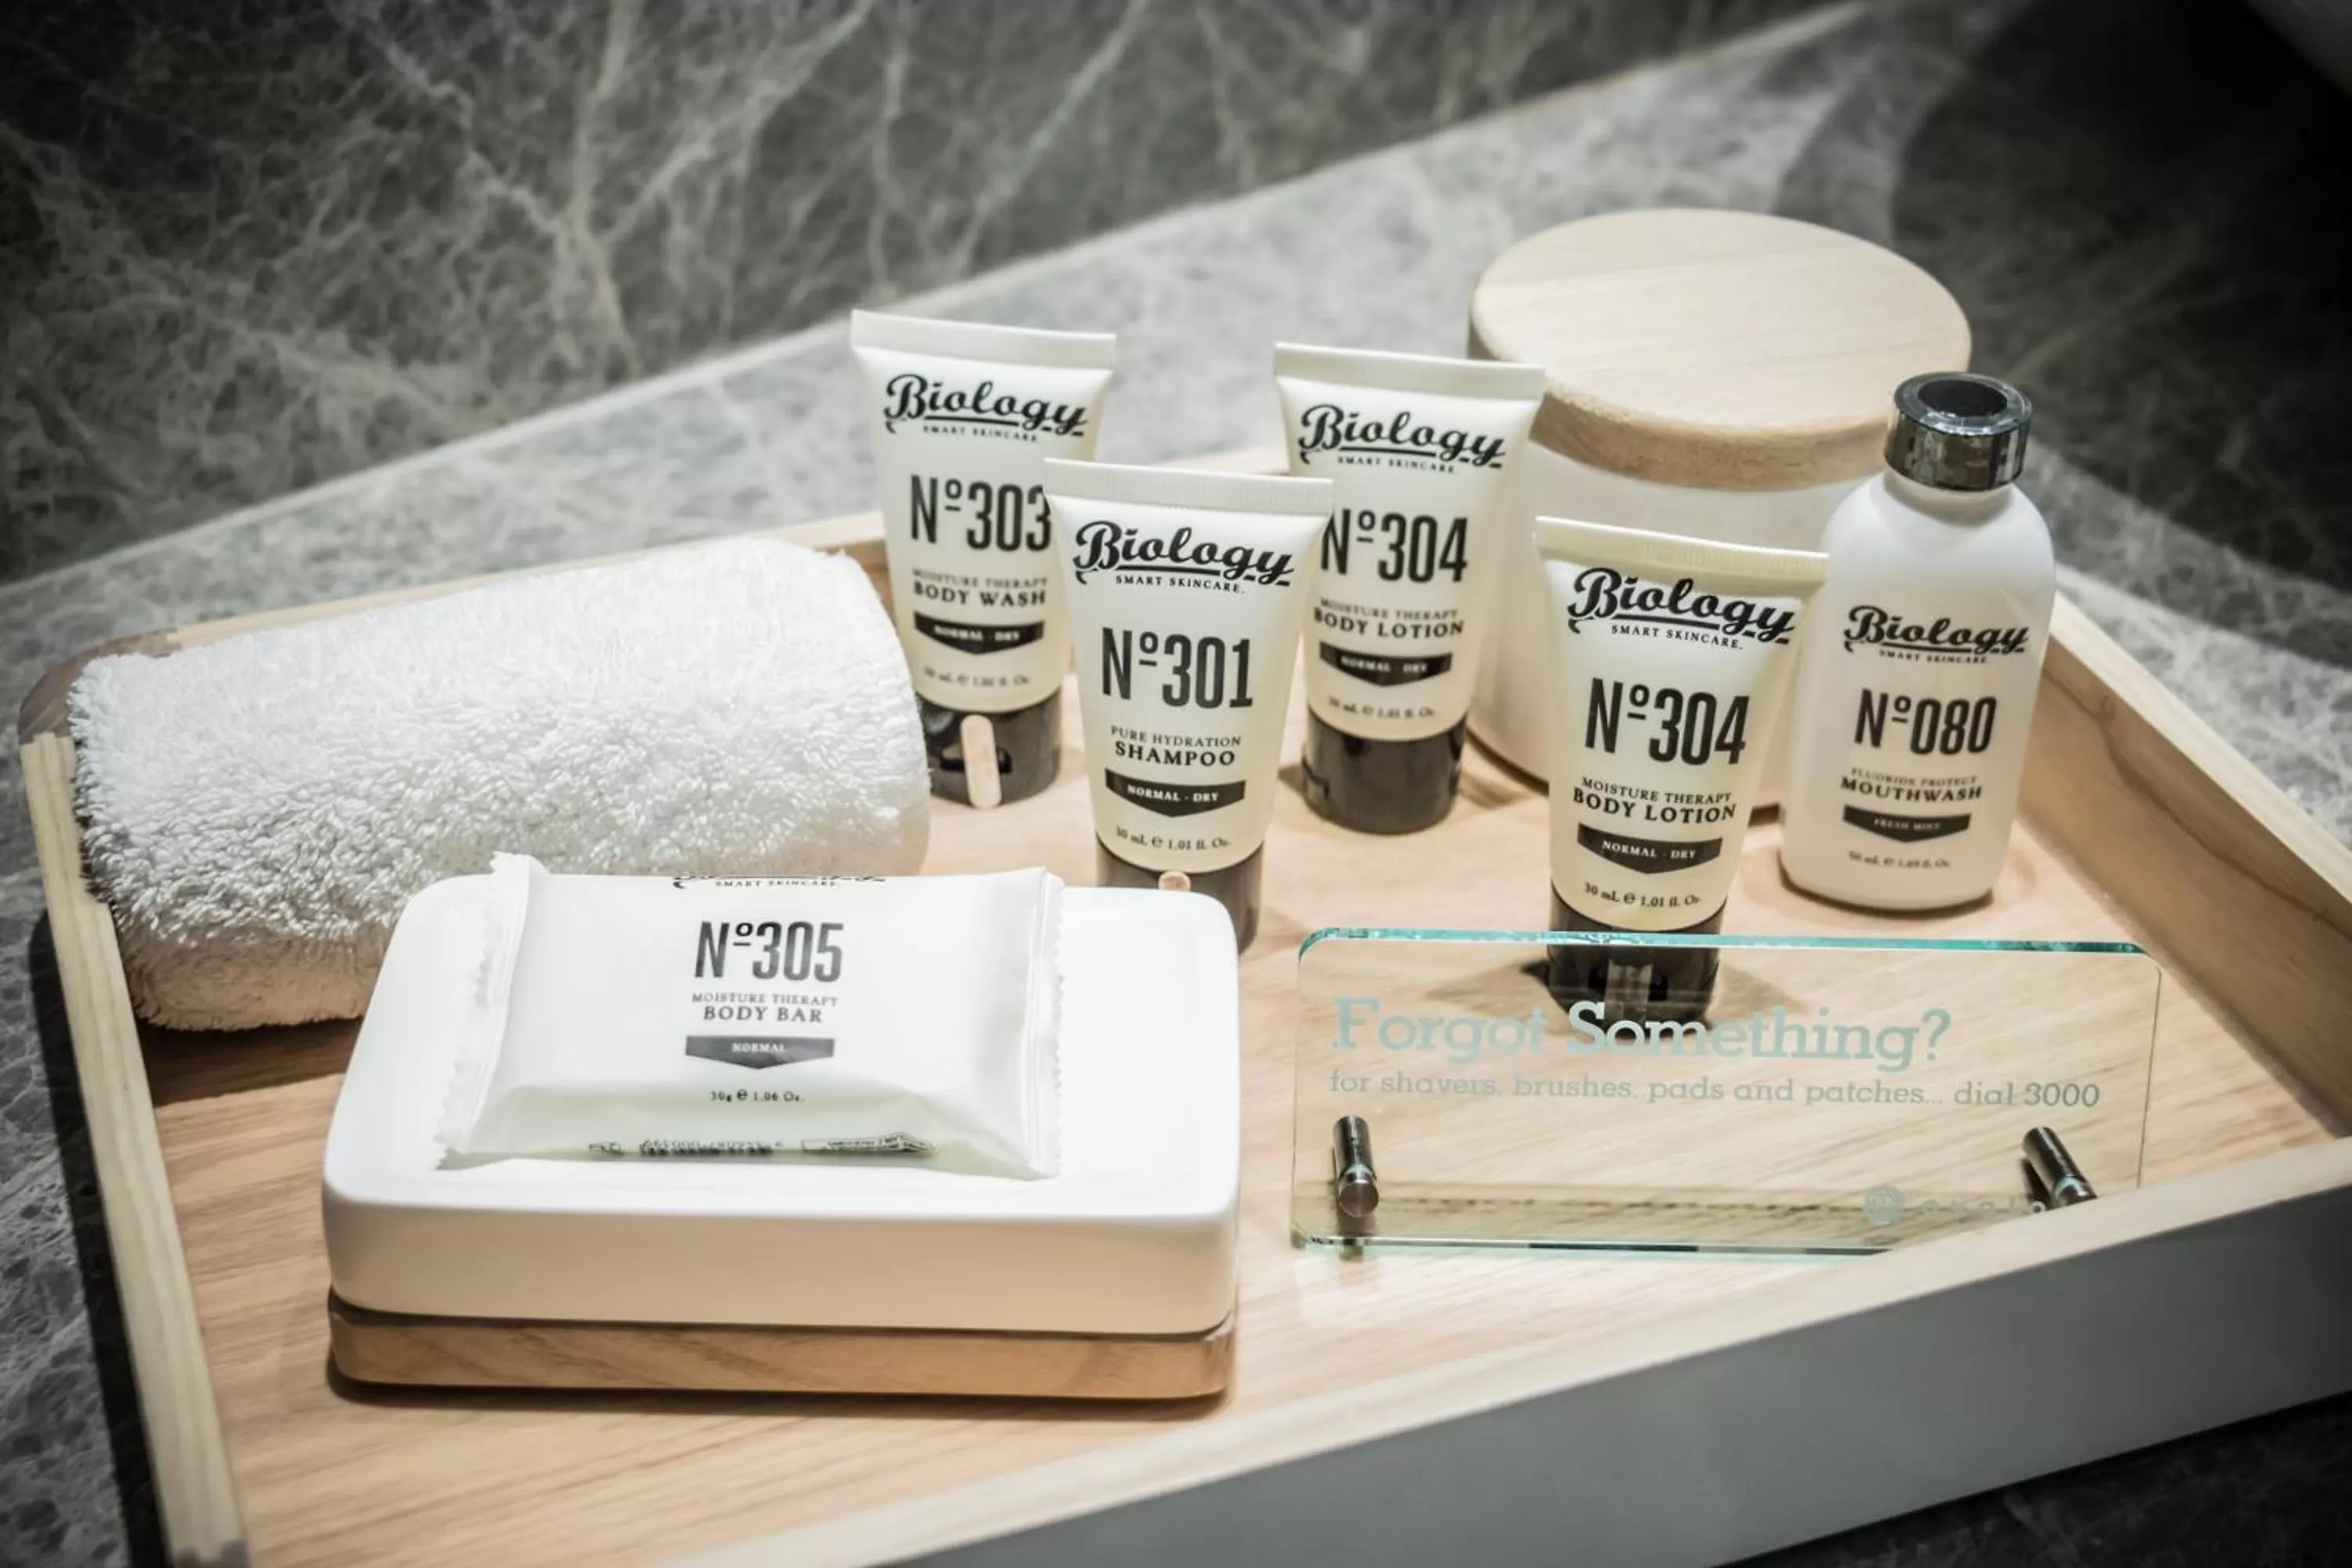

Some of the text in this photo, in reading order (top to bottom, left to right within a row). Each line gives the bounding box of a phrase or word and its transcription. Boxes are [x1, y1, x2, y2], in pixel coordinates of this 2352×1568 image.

[883, 373, 1087, 437] Biology
[923, 425, 966, 436] SMART
[1298, 404, 1505, 468] Biology
[1338, 456, 1381, 466] SMART
[1073, 520, 1294, 586] Biology
[985, 576, 1047, 588] THERAPY
[1116, 575, 1162, 586] SMART
[913, 581, 1046, 608] BODY WASH
[1566, 567, 1795, 645] Biology
[1313, 606, 1465, 639] BODY LOTION
[1395, 608, 1458, 621] THERAPY
[1611, 624, 1660, 638] SMART
[1843, 604, 2029, 655] Biology
[1879, 649, 1920, 662] SMART
[1111, 724, 1241, 747] PURE HYDRATION
[1115, 741, 1236, 767] SHAMPOO
[1127, 784, 1219, 802] NORMAL DRY
[1581, 776, 1732, 804] MOISTURE THERAPY
[1840, 776, 1983, 802] MOUTHWASH
[1573, 786, 1737, 824] BODY LOTION
[1602, 840, 1697, 858] NORMAL DRY
[1640, 895, 1664, 908] 1.01
[691, 992, 839, 1007] MOISTURE THERAPY
[703, 1005, 823, 1023] BODY BAR
[1334, 996, 1951, 1072] Forgot Something?
[731, 1041, 785, 1053] NORMAL
[1330, 1069, 1371, 1093] for
[1649, 1077, 1724, 1104] pads
[1734, 1079, 1793, 1102] and
[1954, 1081, 2013, 1106] dial
[2024, 1082, 2100, 1107] 3000
